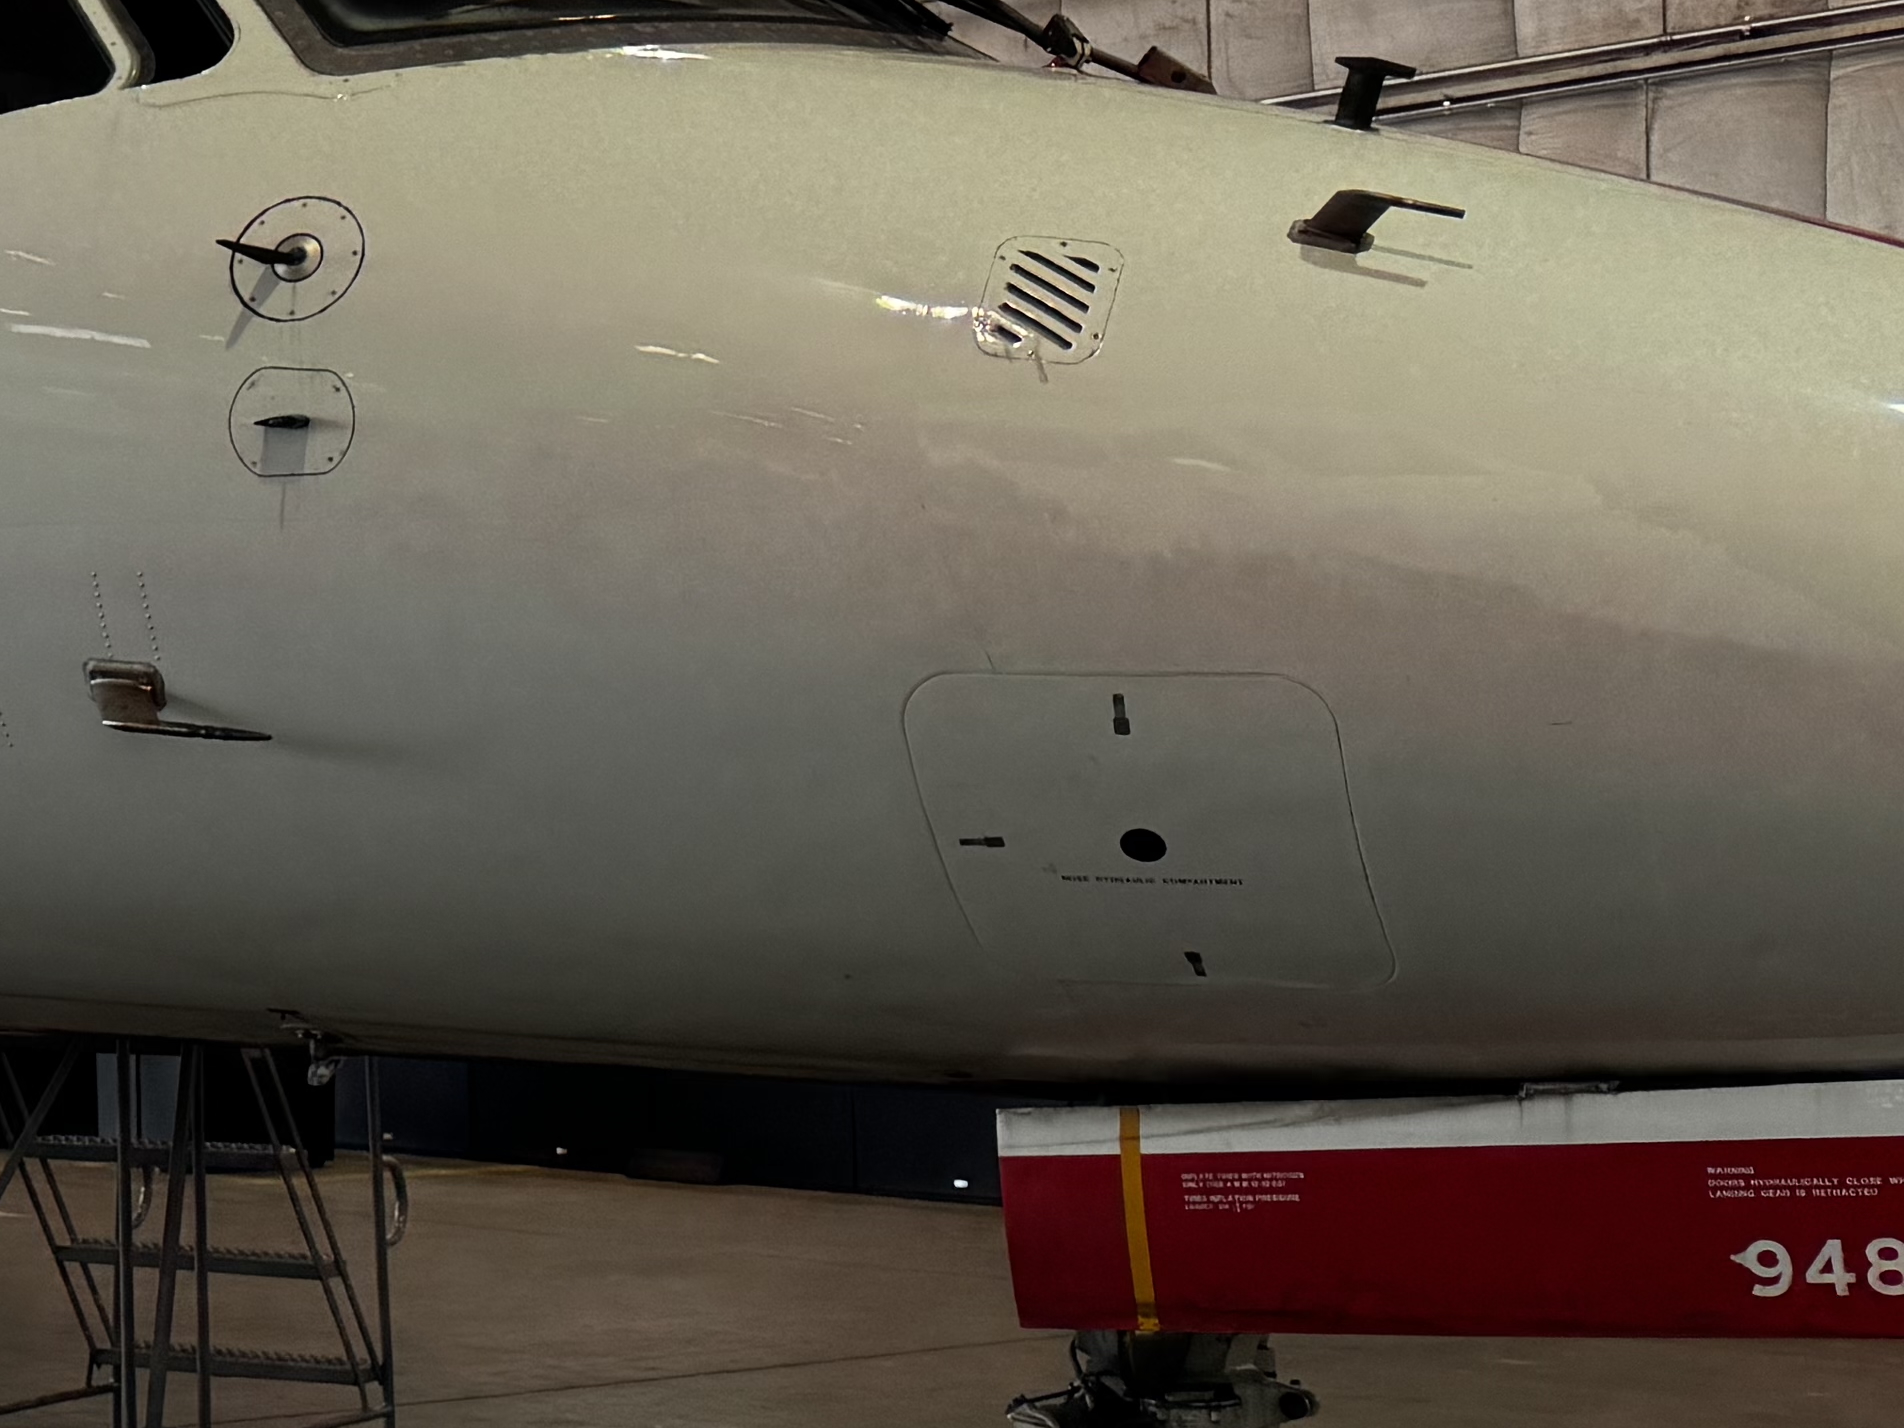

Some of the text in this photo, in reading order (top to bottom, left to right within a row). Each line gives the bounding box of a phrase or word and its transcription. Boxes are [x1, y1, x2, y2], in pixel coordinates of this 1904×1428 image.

[1162, 878, 1243, 886] COMPARTMENT
[1750, 1177, 1839, 1186] HYDRAULICALLY
[1846, 1177, 1882, 1185] CLOSE
[1760, 1189, 1790, 1197] GEAR
[1795, 1189, 1806, 1197] IS
[1812, 1188, 1878, 1197] RETRACTED
[1730, 1237, 1904, 1297] 948
